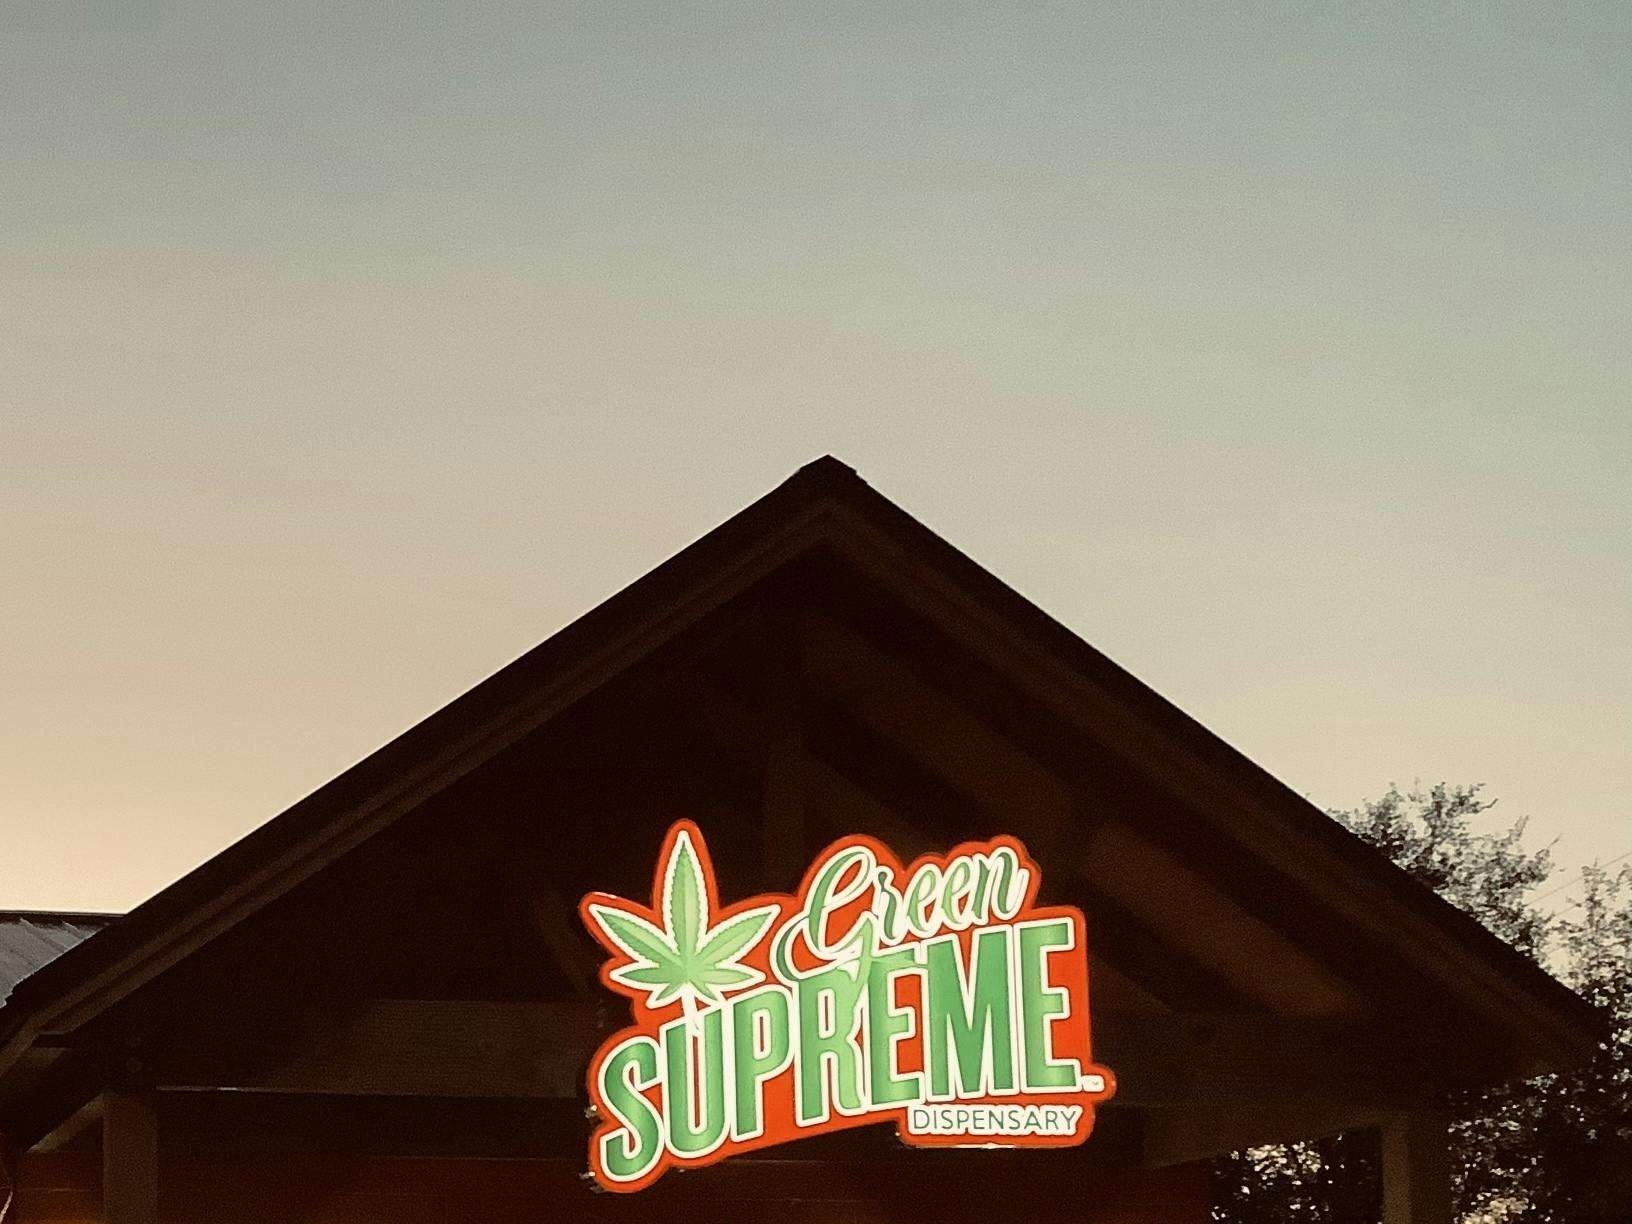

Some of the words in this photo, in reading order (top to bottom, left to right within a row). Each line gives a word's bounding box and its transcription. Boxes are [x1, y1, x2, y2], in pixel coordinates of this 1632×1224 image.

[772, 846, 1030, 983] Green
[598, 917, 1082, 1182] SUPREME
[912, 1108, 1077, 1131] DISPENSARY
